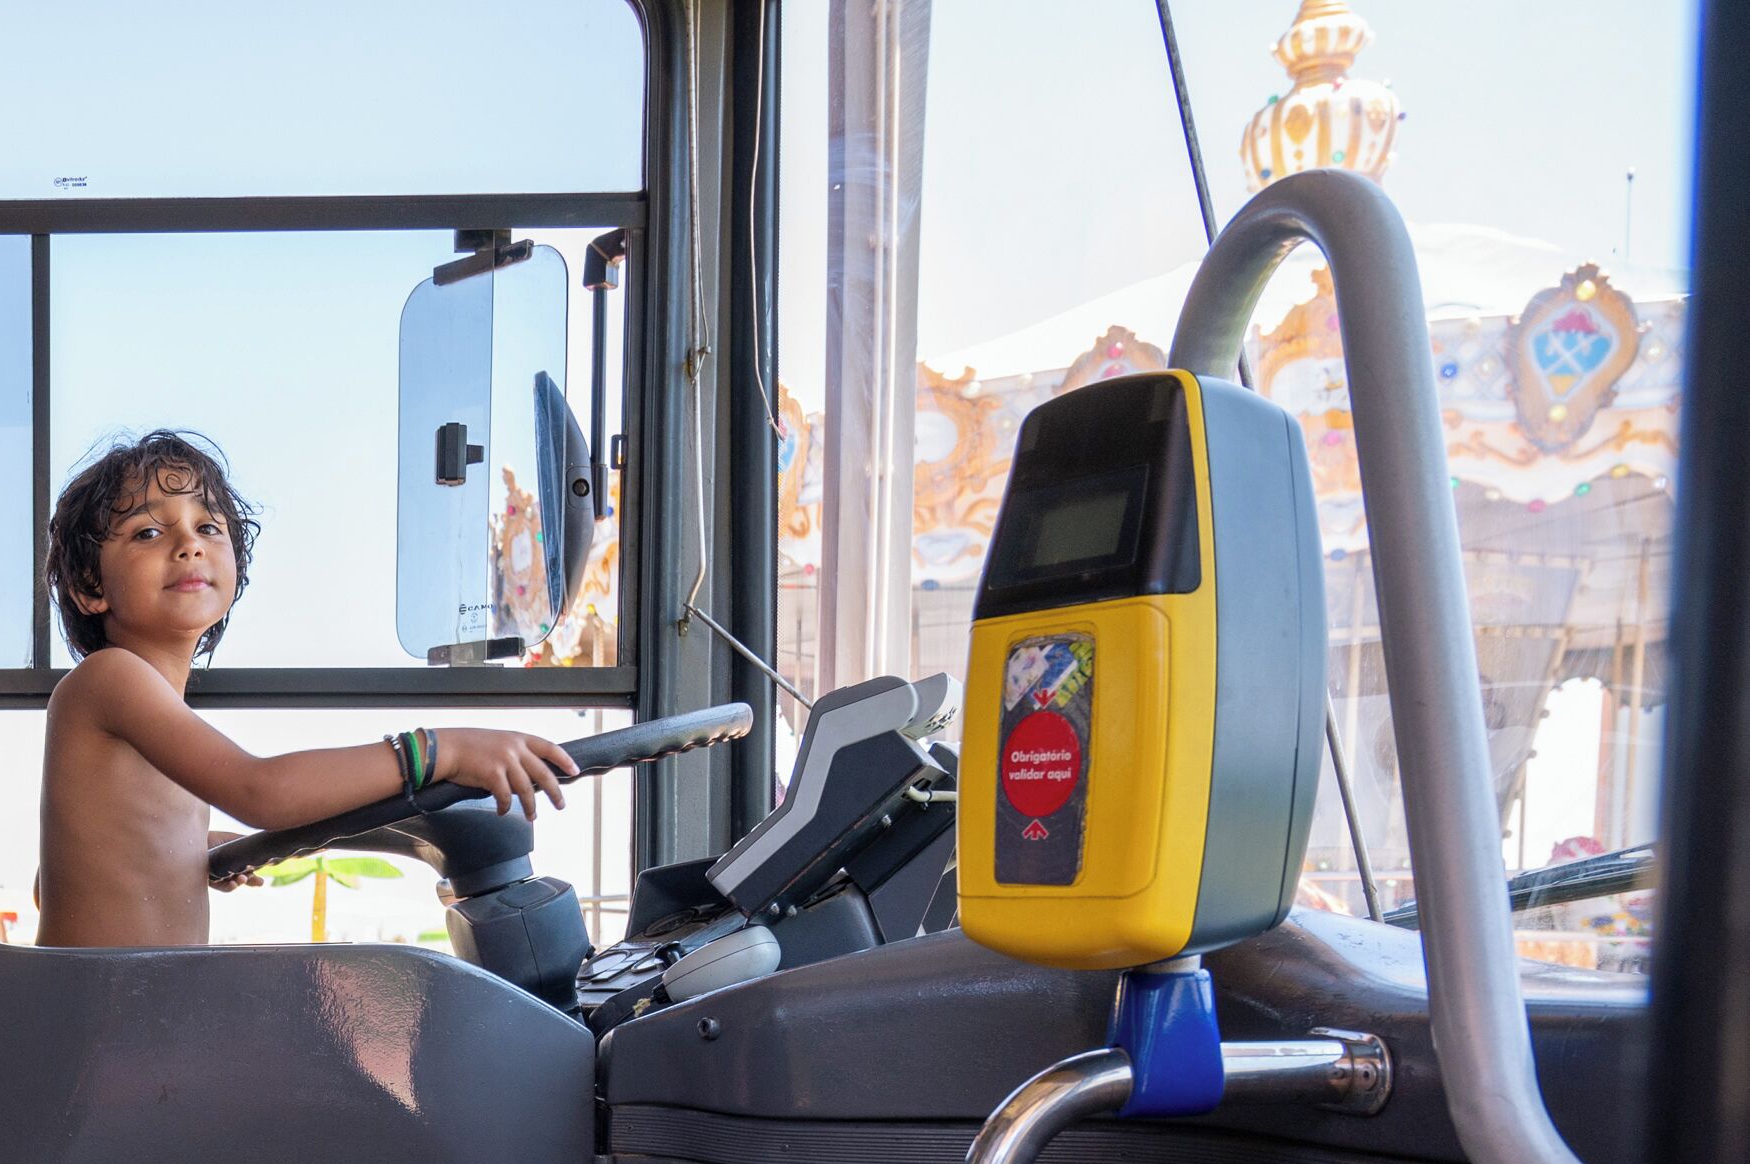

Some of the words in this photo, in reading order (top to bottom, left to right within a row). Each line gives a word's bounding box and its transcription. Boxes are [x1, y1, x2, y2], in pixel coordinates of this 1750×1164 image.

[1011, 751, 1071, 764] Obrigatório
[1009, 769, 1044, 780] validar
[1047, 768, 1071, 781] aqui
